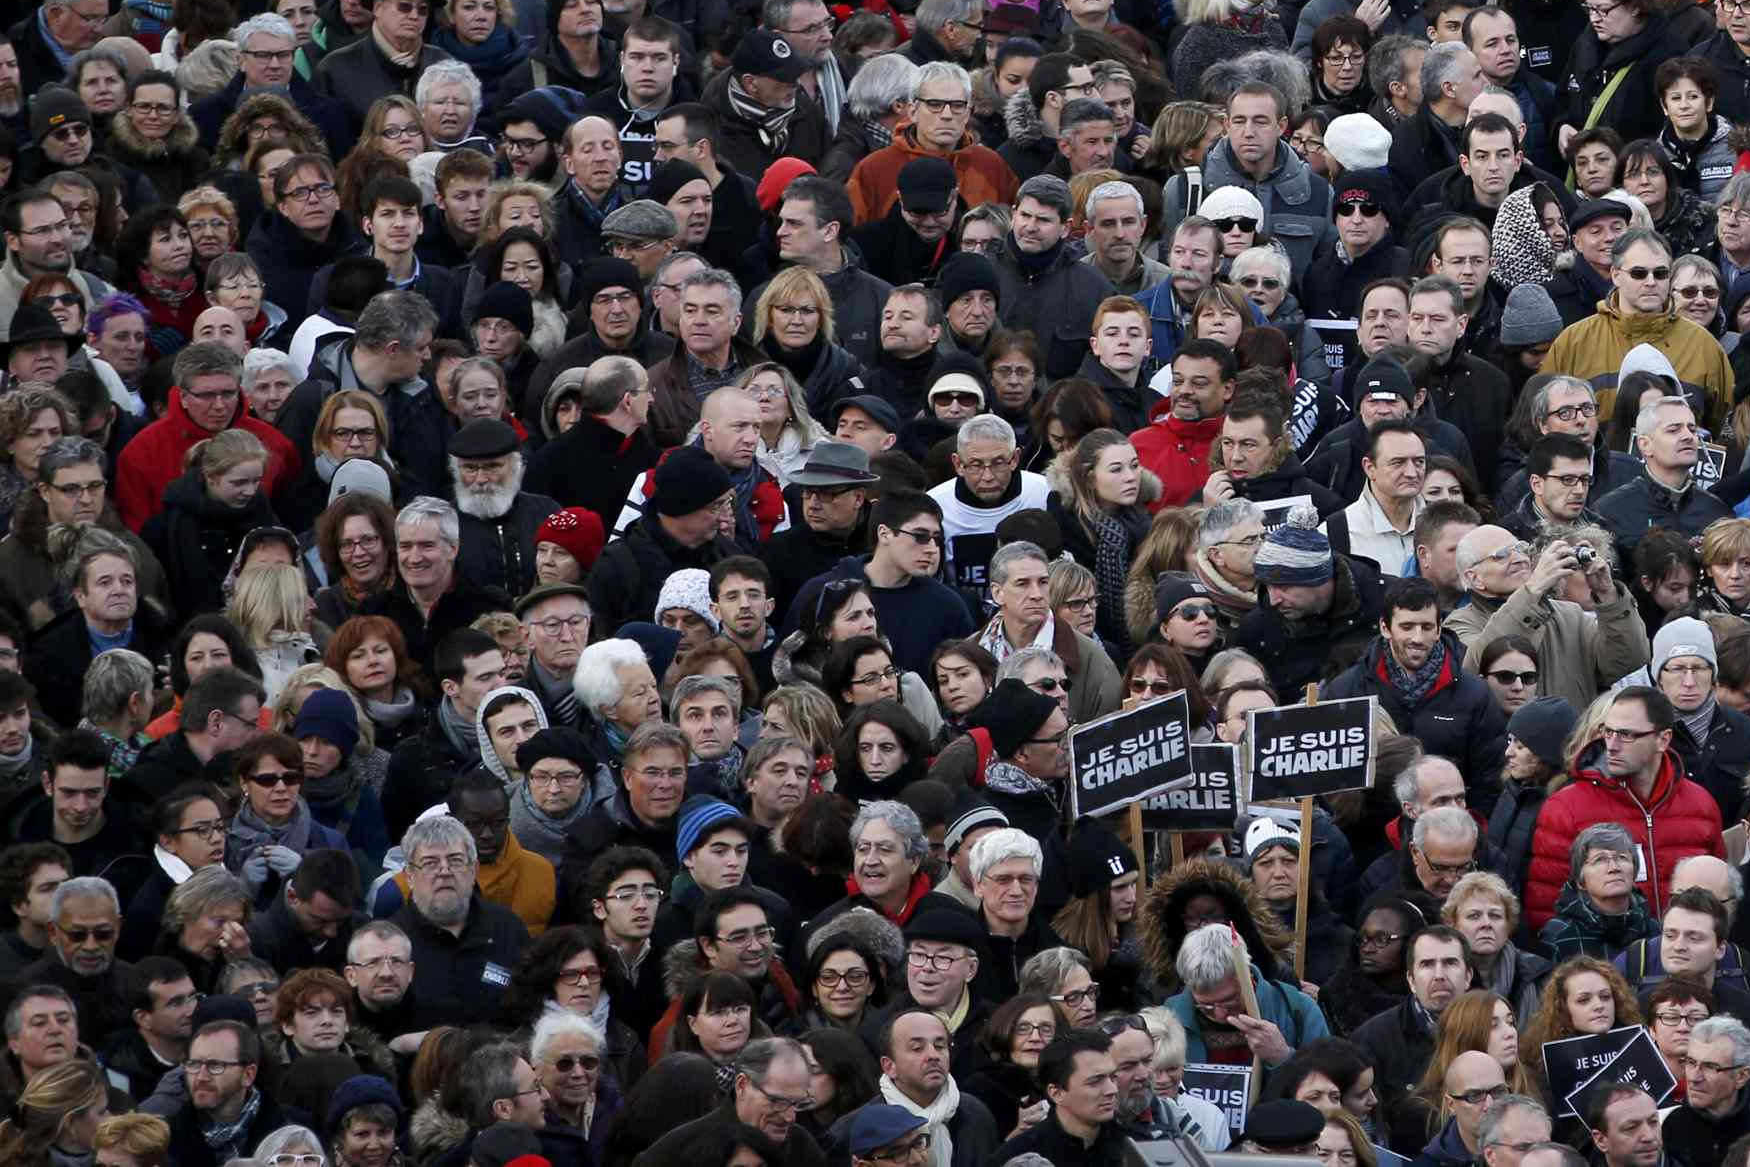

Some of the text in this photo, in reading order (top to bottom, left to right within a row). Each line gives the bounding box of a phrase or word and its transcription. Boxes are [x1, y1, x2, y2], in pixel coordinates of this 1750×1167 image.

[959, 565, 987, 584] JE
[1082, 720, 1183, 769] JE SUIS
[1261, 727, 1364, 756] JE SUIS
[1082, 736, 1186, 790] CHARLIE
[1261, 746, 1365, 778] CHARLIE
[1576, 1055, 1589, 1071] JE
[1617, 1066, 1638, 1085] UIS
